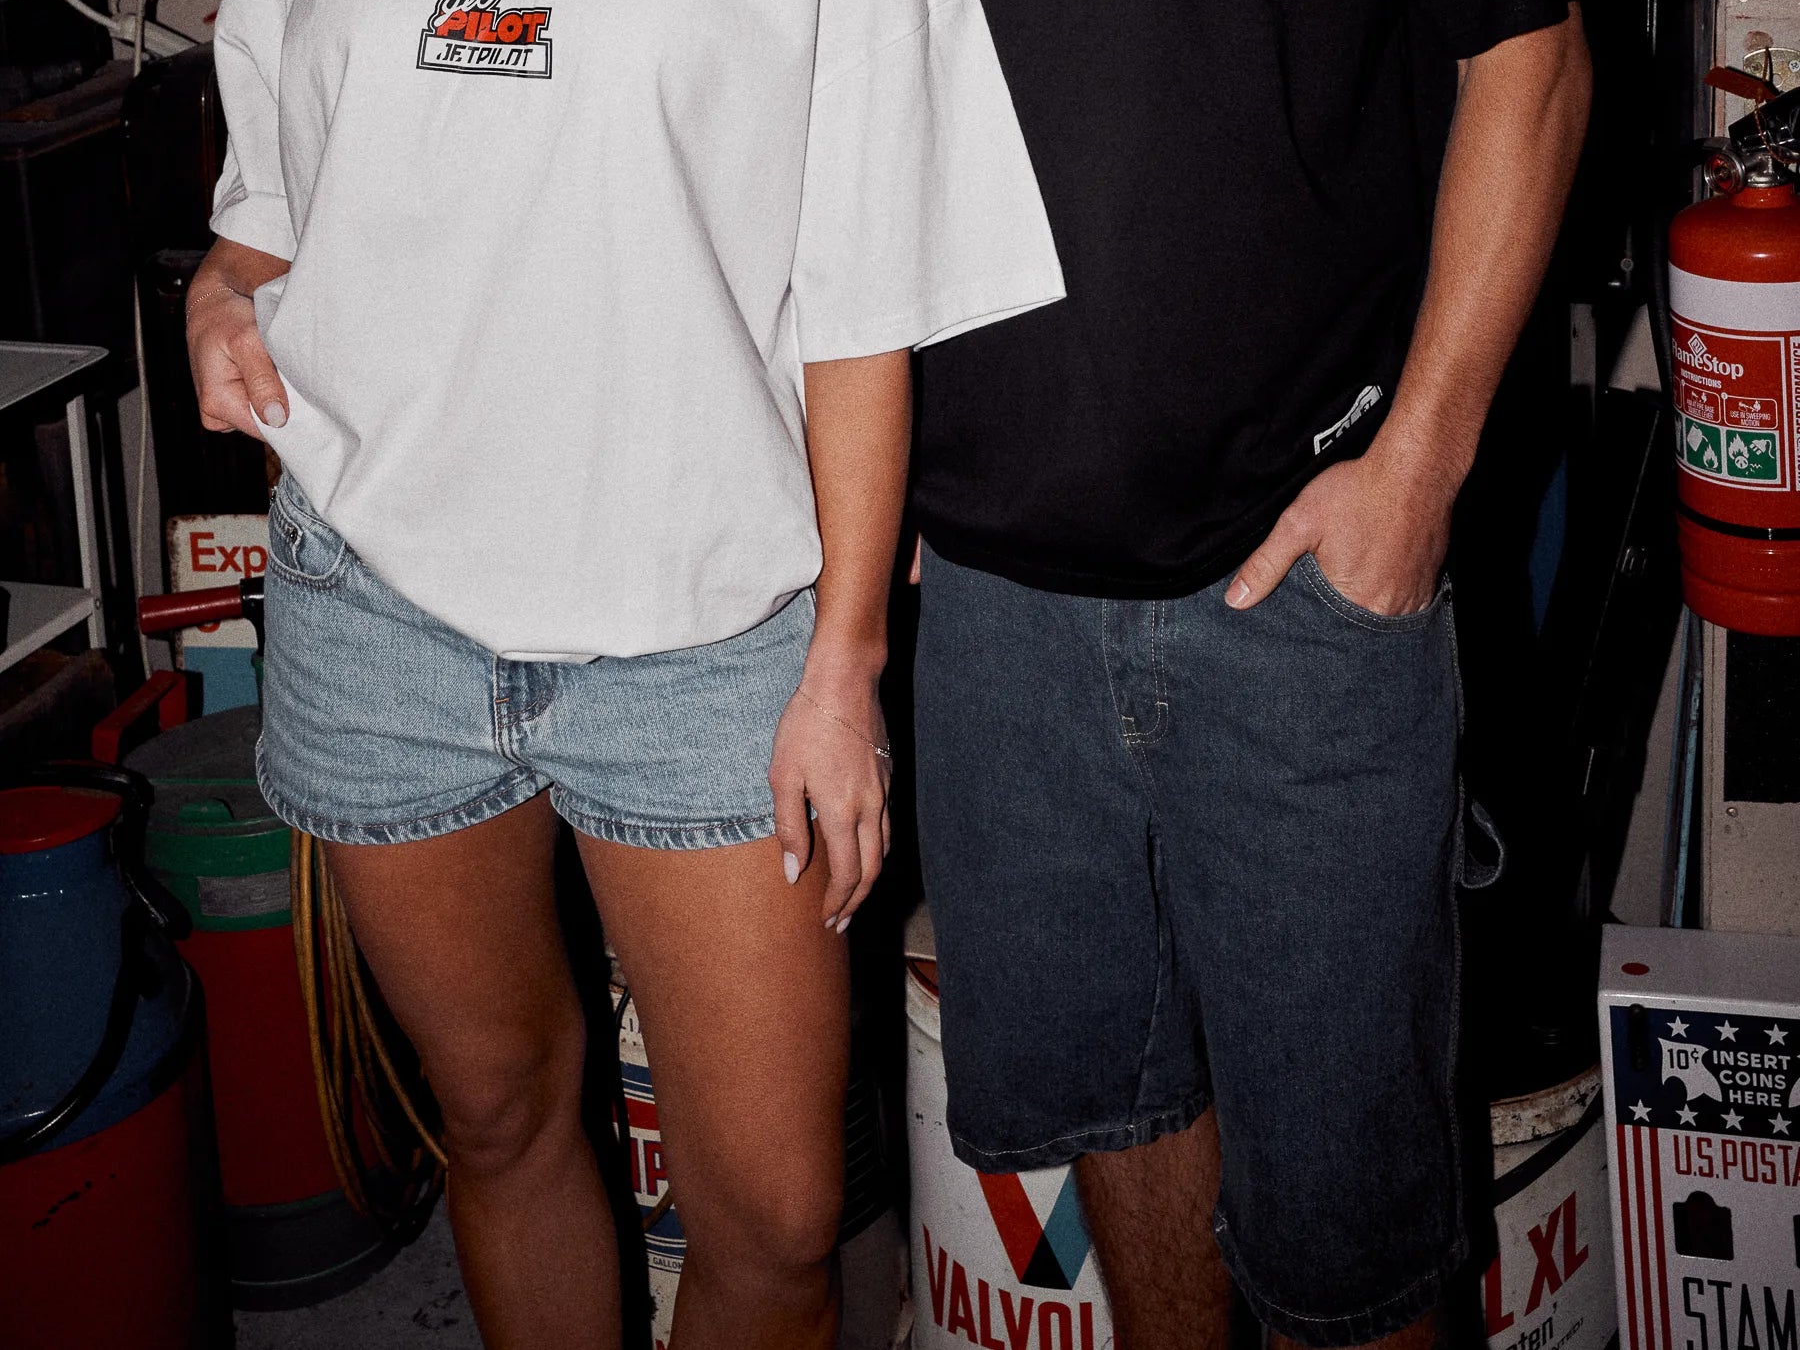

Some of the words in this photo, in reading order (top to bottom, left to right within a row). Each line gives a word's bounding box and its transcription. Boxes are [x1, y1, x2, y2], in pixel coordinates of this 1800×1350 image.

[436, 10, 547, 43] PILOT
[189, 532, 269, 579] Exp
[1713, 1050, 1790, 1071] INSERT
[1719, 1070, 1787, 1090] COINS
[1729, 1090, 1782, 1108] HERE
